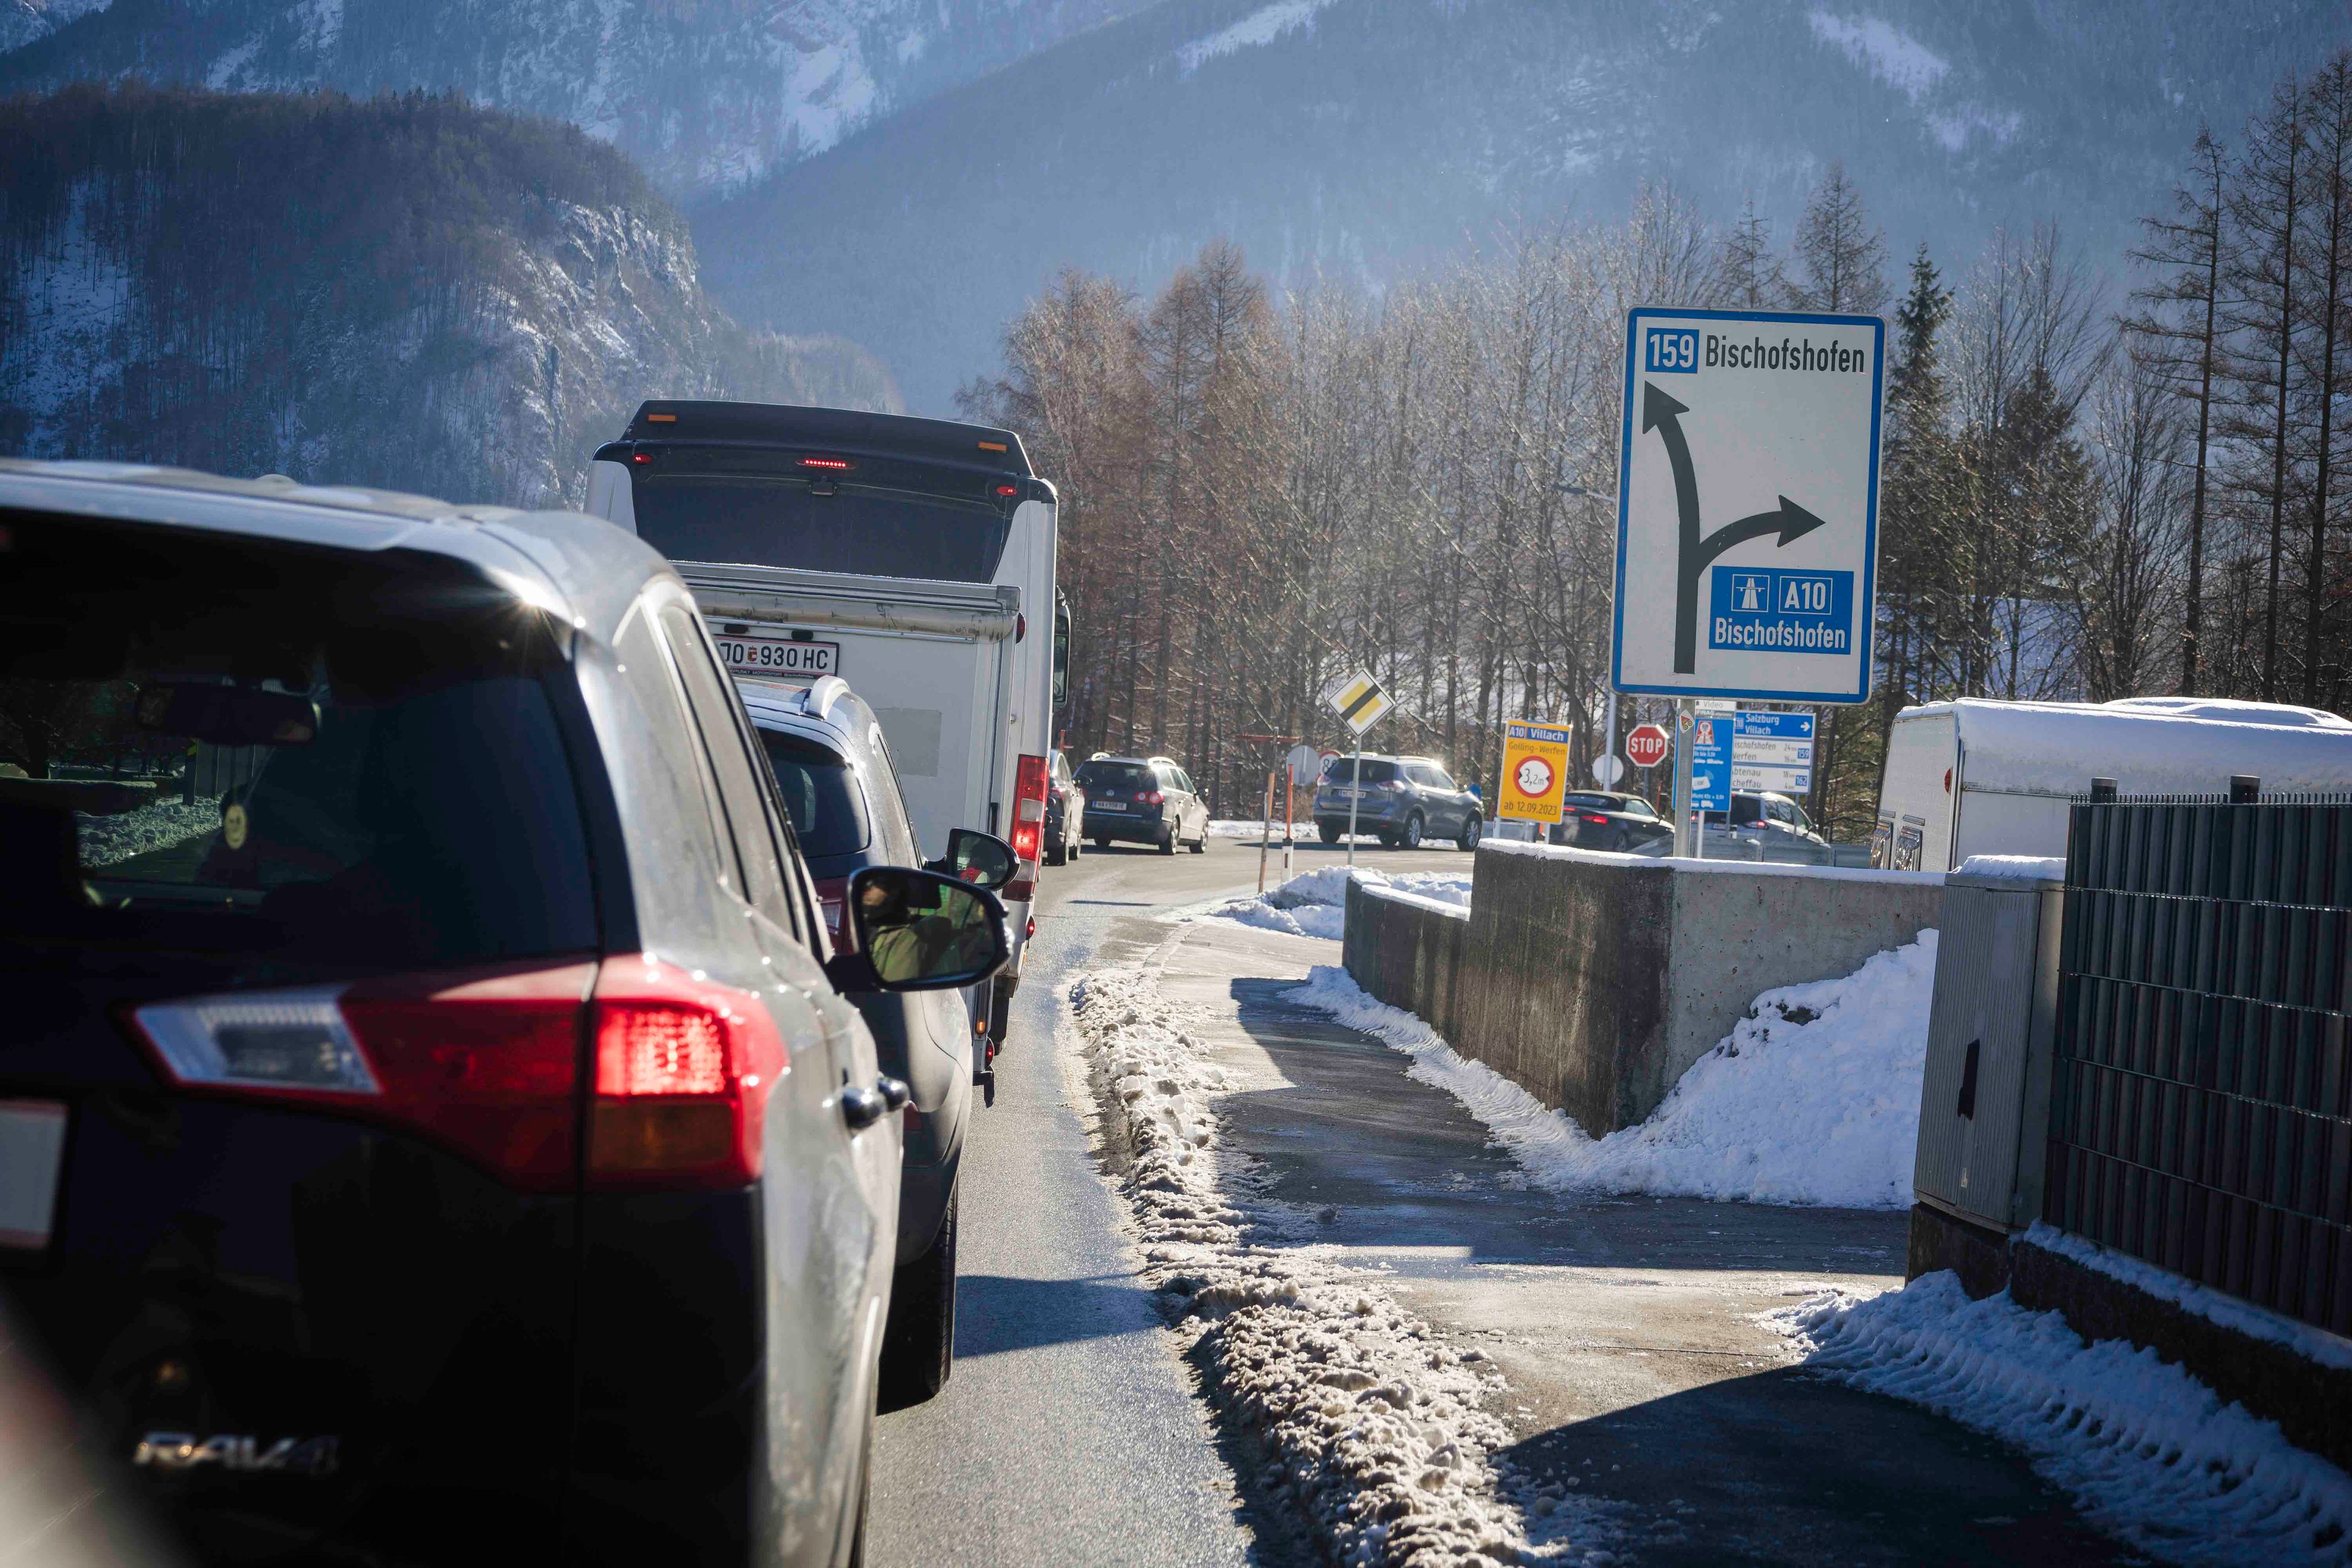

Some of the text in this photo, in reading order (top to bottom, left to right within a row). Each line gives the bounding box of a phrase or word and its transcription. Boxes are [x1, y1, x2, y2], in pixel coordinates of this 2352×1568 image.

[1649, 333, 1865, 373] 159 Bischofshofen
[1784, 581, 1826, 610] A10
[1715, 617, 1845, 648] Bischofshofen
[720, 643, 828, 670] JO 930 HC
[1745, 713, 1780, 726] Salzburg
[1509, 726, 1564, 741] A10 Villach
[1745, 725, 1771, 735] Villach
[1631, 737, 1663, 753] STOP
[1735, 740, 1776, 751] ischofshofen
[1798, 748, 1809, 758] 159
[1732, 767, 1761, 777] btenau
[1732, 778, 1761, 788] cheffau
[1797, 776, 1807, 785] 162
[1504, 801, 1557, 815] ab 12.09.2023
